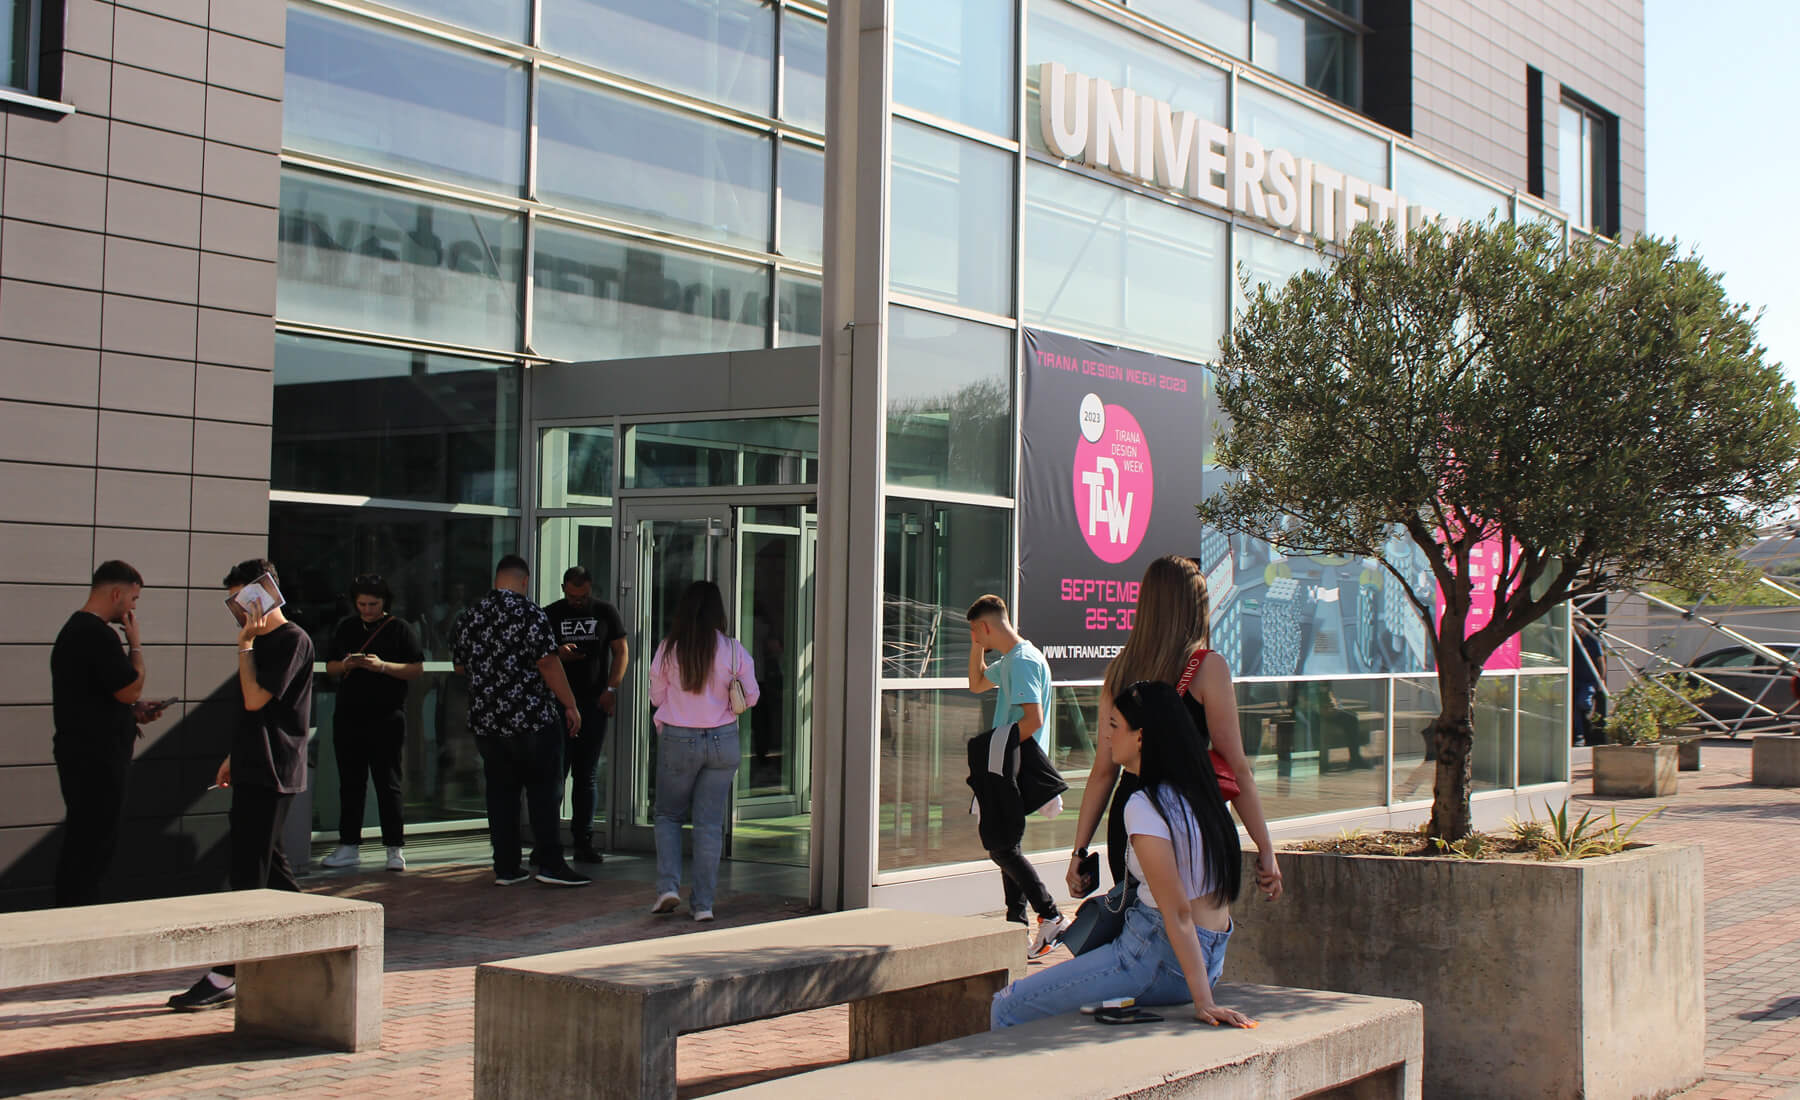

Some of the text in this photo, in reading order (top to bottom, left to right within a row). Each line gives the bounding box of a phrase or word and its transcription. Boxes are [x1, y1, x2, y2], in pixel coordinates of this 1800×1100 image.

[1036, 350, 1187, 393] TIRANA DESIGN WEEK 2023
[1084, 410, 1101, 424] 2023
[1114, 428, 1141, 445] TIRANA
[1111, 443, 1138, 458] DESIGN
[1123, 460, 1144, 474] WEEK
[1061, 578, 1141, 603] SEPTEMB
[560, 619, 598, 636] EA7
[1085, 607, 1137, 631] 25-30
